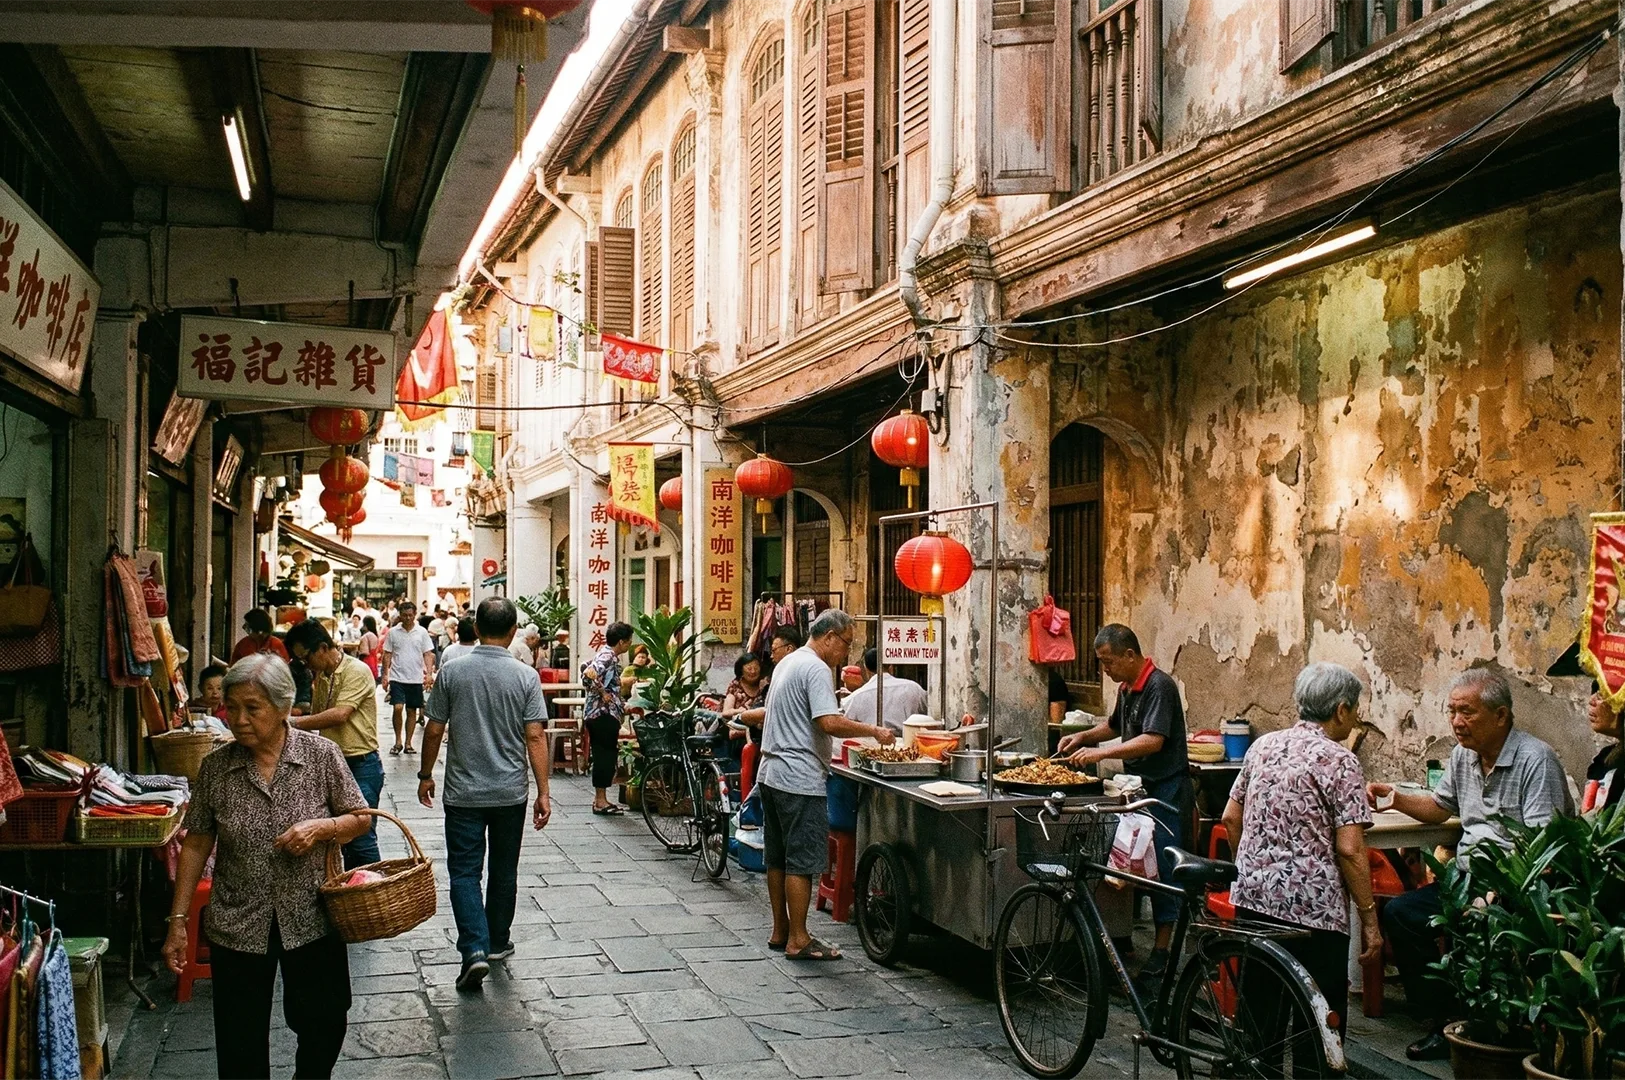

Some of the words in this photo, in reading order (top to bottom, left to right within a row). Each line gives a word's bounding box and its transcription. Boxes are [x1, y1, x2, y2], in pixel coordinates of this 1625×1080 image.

[191, 333, 385, 395] 福記雜貨
[710, 477, 734, 612] 南洋咖啡店
[885, 647, 902, 658] CHAR
[903, 648, 920, 658] KWAY
[921, 648, 939, 659] TEOW
